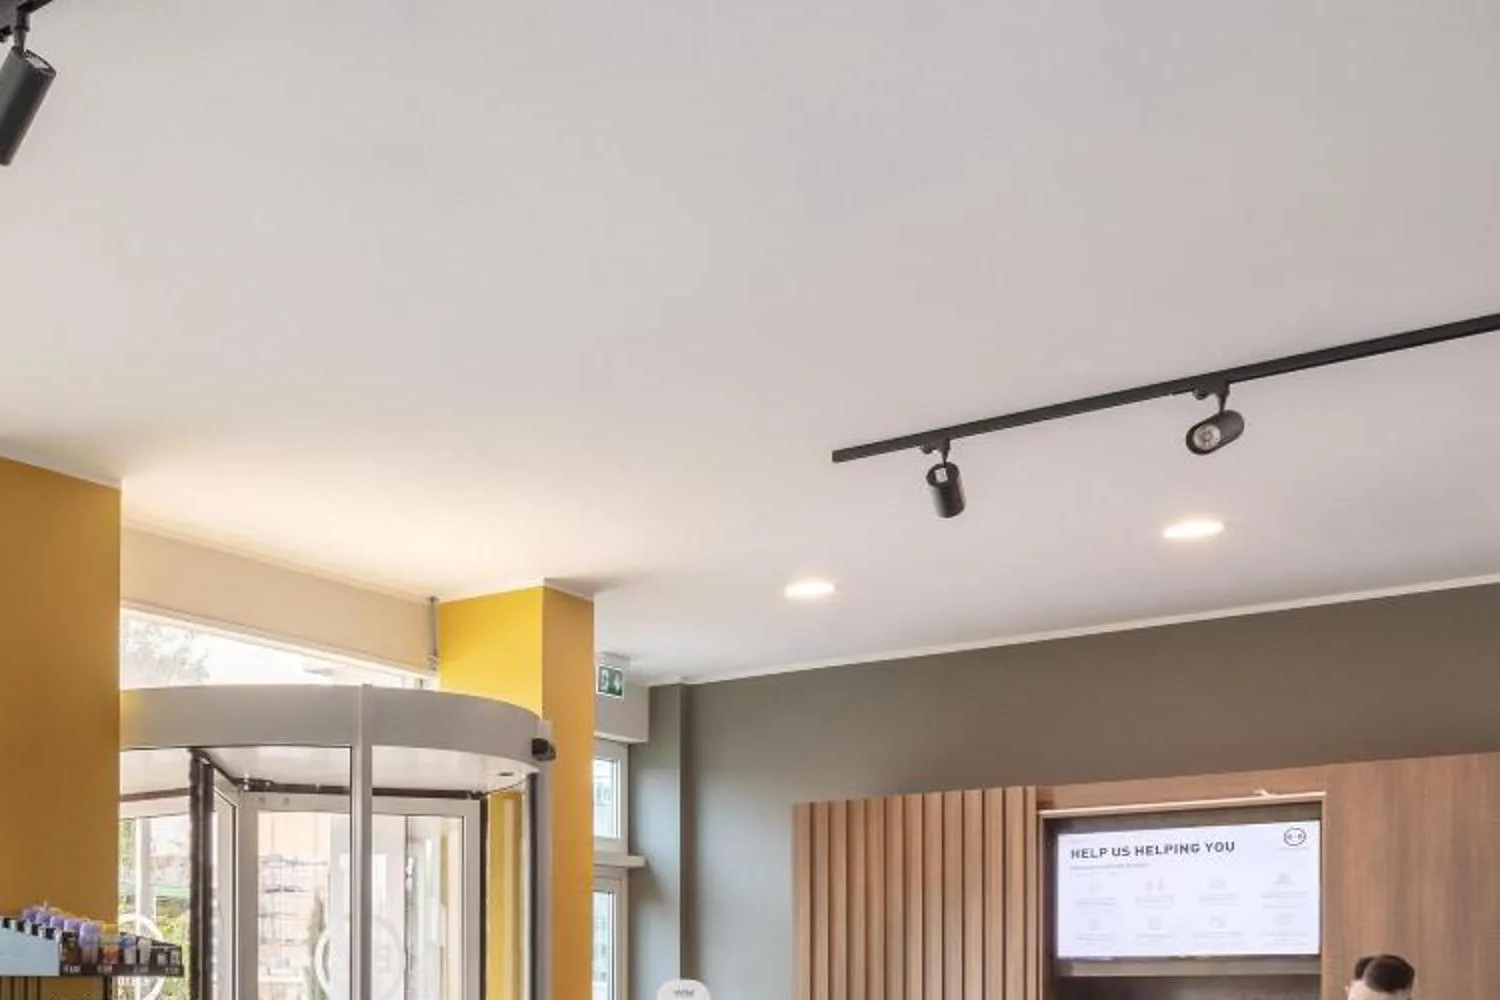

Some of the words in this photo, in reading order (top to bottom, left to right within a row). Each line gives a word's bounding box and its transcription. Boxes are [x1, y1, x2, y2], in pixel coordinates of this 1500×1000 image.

[1070, 847, 1107, 860] HELP
[1111, 845, 1131, 857] US
[1135, 843, 1200, 857] HELPING
[1205, 841, 1236, 853] YOU
